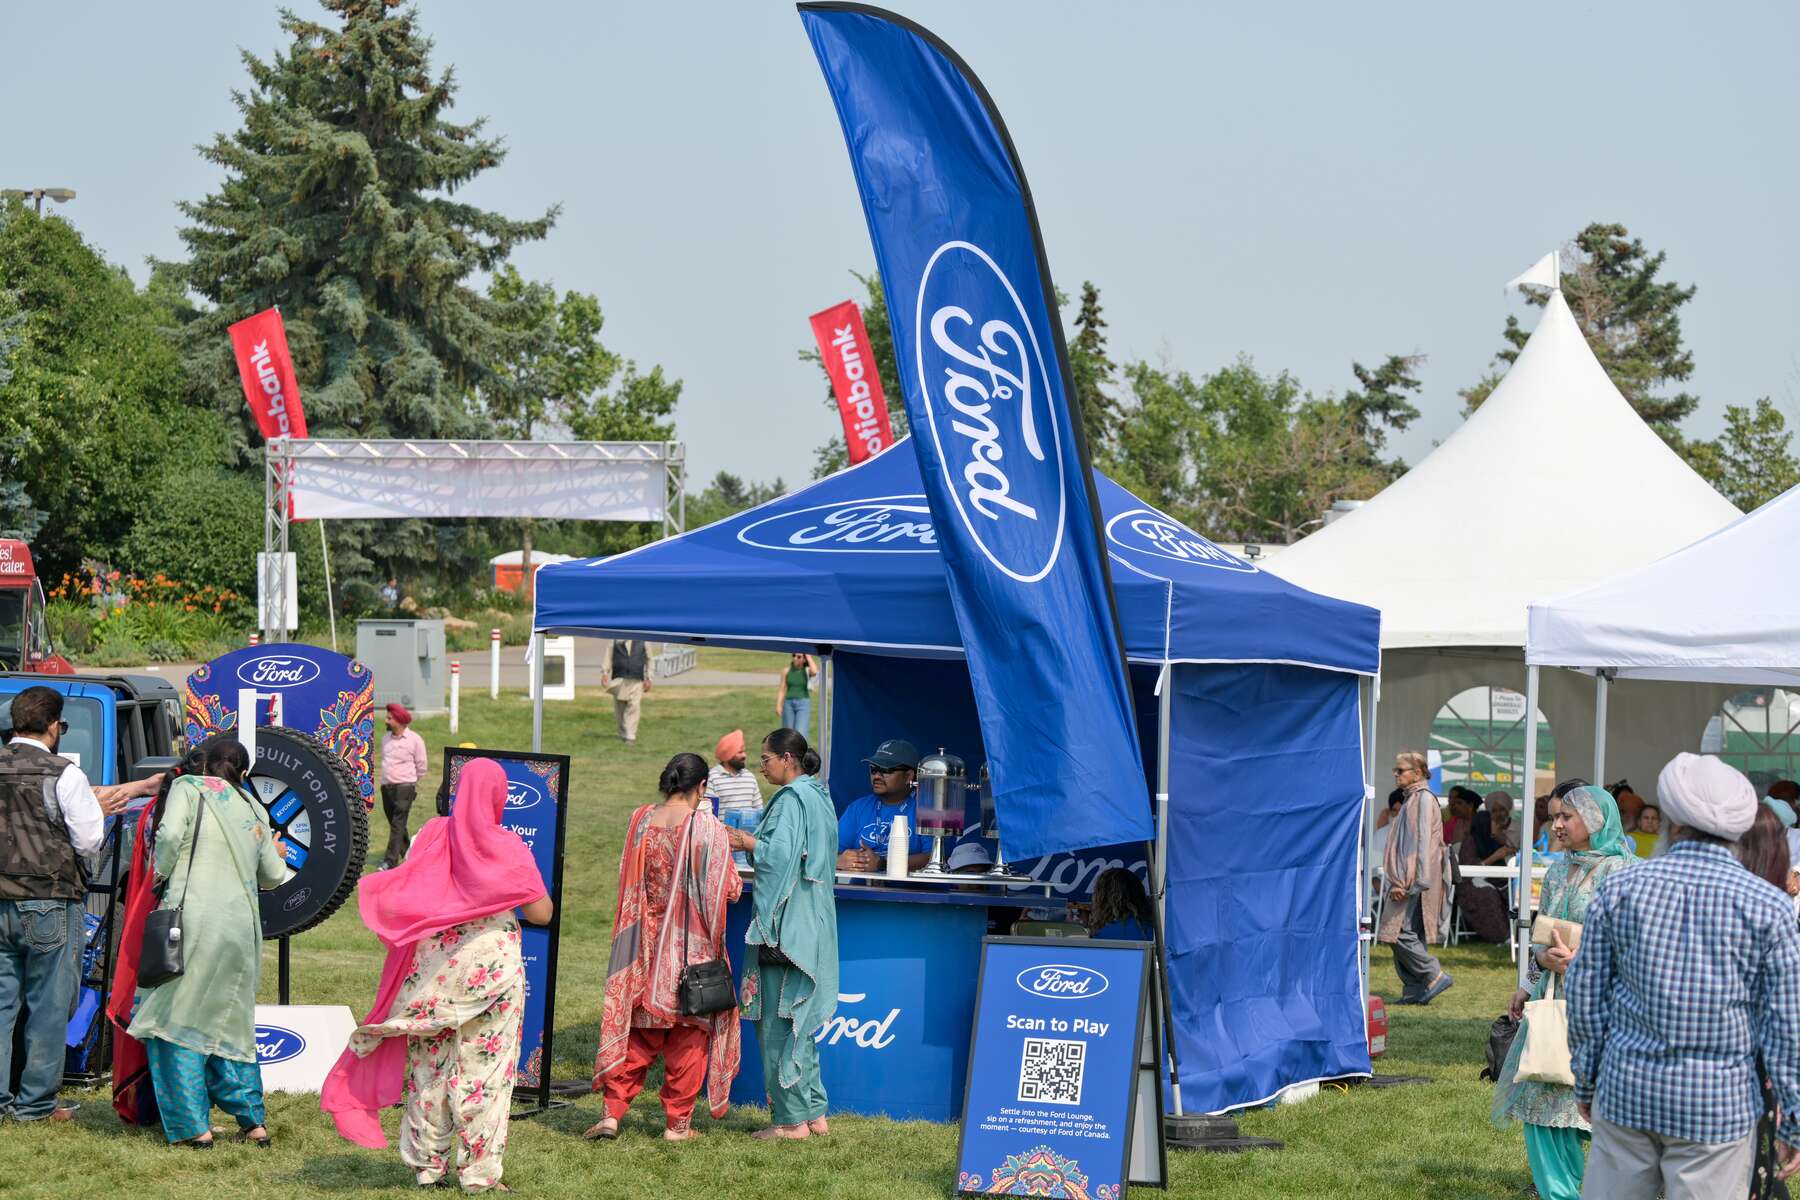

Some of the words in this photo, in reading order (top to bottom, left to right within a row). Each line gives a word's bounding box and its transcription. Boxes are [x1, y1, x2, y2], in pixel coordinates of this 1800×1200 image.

[832, 323, 882, 455] otiabank
[931, 306, 1045, 521] Ford
[0, 544, 13, 560] es!
[1131, 519, 1242, 566] Ford
[253, 660, 304, 682] Ford
[256, 746, 303, 771] BUILT
[302, 770, 328, 804] FOR
[322, 808, 337, 855] PLAY
[506, 786, 528, 805] rd
[511, 825, 538, 837] Your
[1033, 968, 1092, 994] Ford
[1006, 1014, 1045, 1031] Scan
[1050, 1017, 1069, 1032] to
[1073, 1018, 1109, 1037] Play
[256, 1032, 285, 1058] rd
[986, 1115, 997, 1123] sip
[1059, 1120, 1073, 1128] and
[1074, 1122, 1093, 1130] enjoy
[1000, 1108, 1020, 1116] Settle
[1022, 1109, 1036, 1117] into
[1037, 1110, 1049, 1118] the
[1050, 1111, 1066, 1119] Ford
[1067, 1112, 1094, 1121] Lounge,
[1018, 1126, 1048, 1135] courtesy
[1083, 1130, 1111, 1139] Canada.
